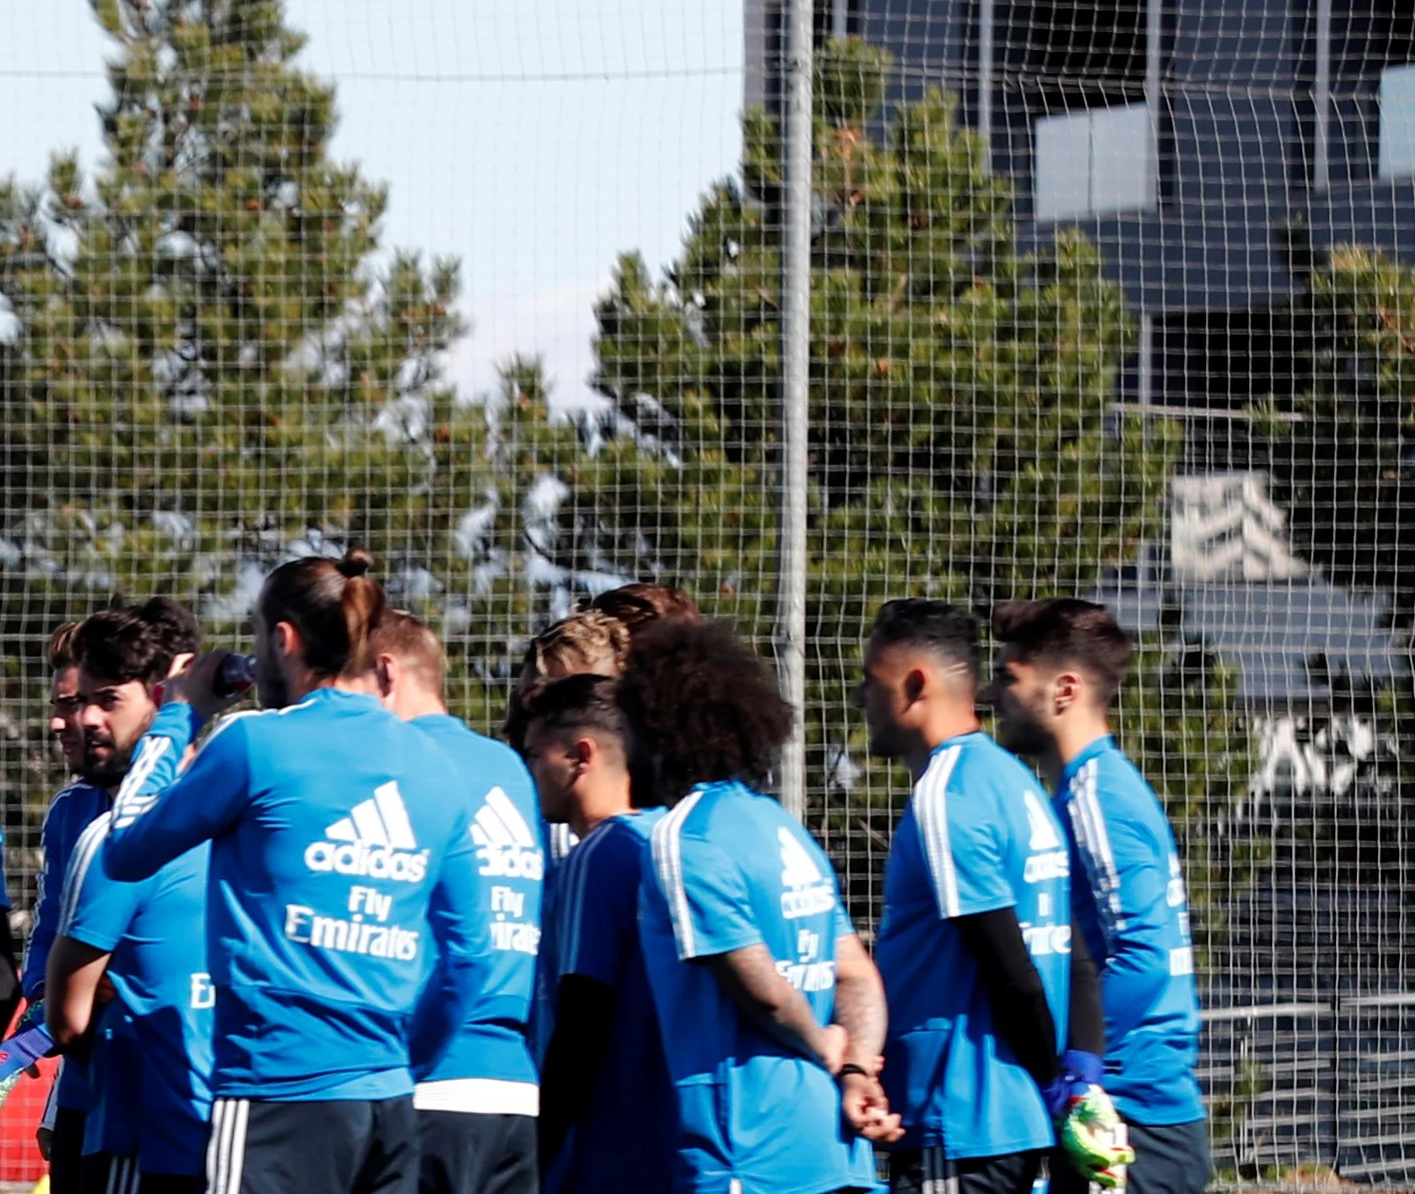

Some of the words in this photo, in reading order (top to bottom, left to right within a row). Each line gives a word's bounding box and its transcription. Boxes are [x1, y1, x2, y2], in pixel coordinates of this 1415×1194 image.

[304, 840, 429, 883] adidas
[348, 885, 392, 921] Fly
[491, 886, 524, 918] Fly
[285, 904, 419, 961] Emirates
